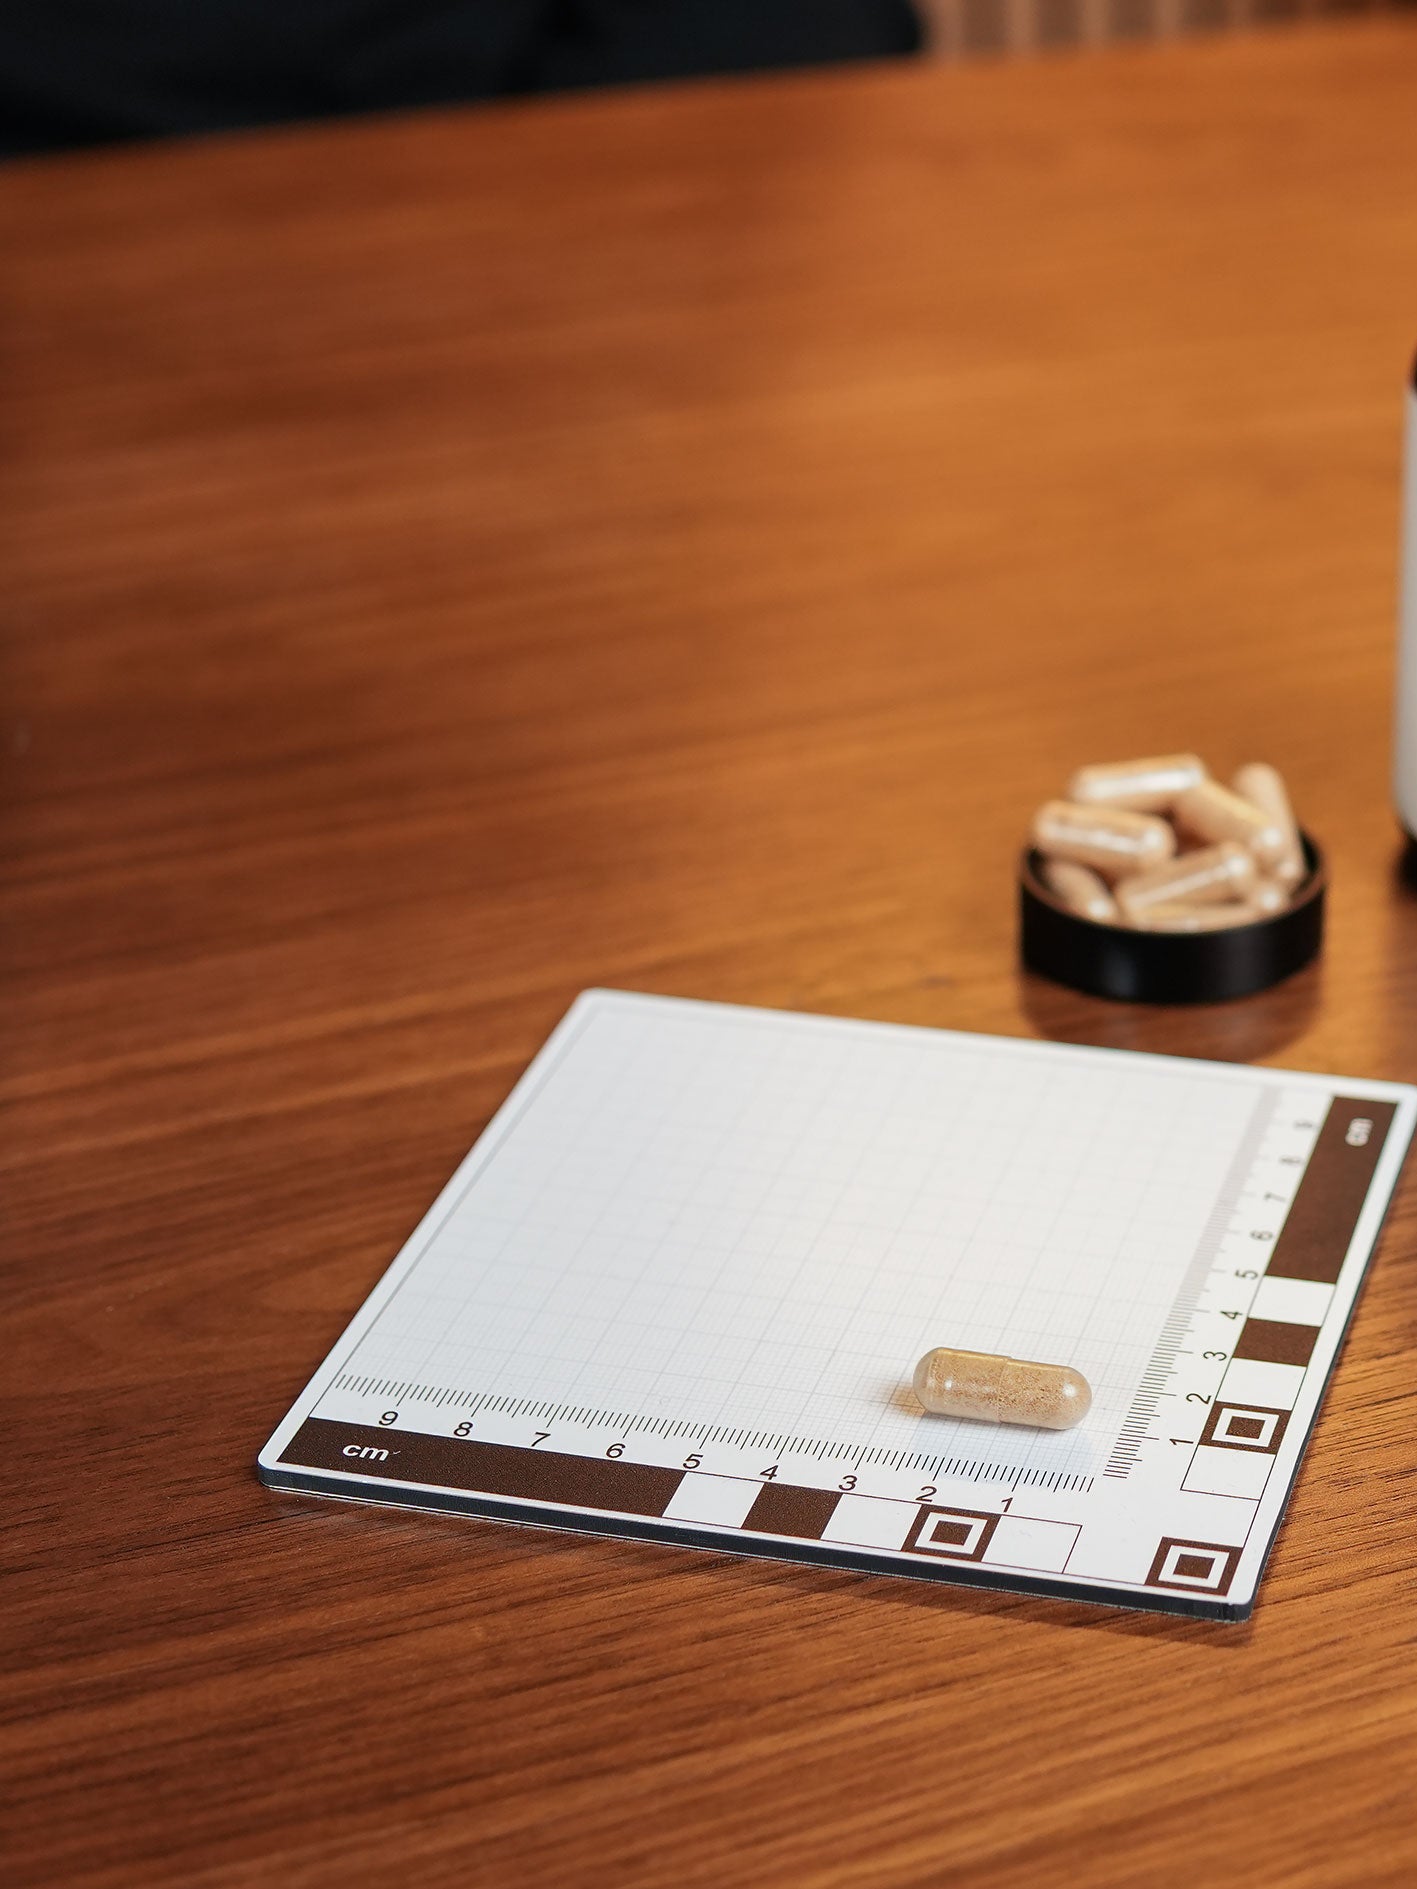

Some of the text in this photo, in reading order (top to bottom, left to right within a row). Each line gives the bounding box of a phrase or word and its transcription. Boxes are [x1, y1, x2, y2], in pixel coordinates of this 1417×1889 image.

[1169, 1438, 1194, 1446] 1
[1185, 1393, 1212, 1405] 2
[1203, 1351, 1227, 1362] 3
[1220, 1310, 1243, 1320] 4
[1235, 1269, 1260, 1280] 5
[1249, 1230, 1274, 1242] 6
[1263, 1192, 1288, 1204] 7
[342, 1441, 390, 1463] cm
[378, 1410, 1014, 1514] 9 8 7 6 5 4 3 2 1
